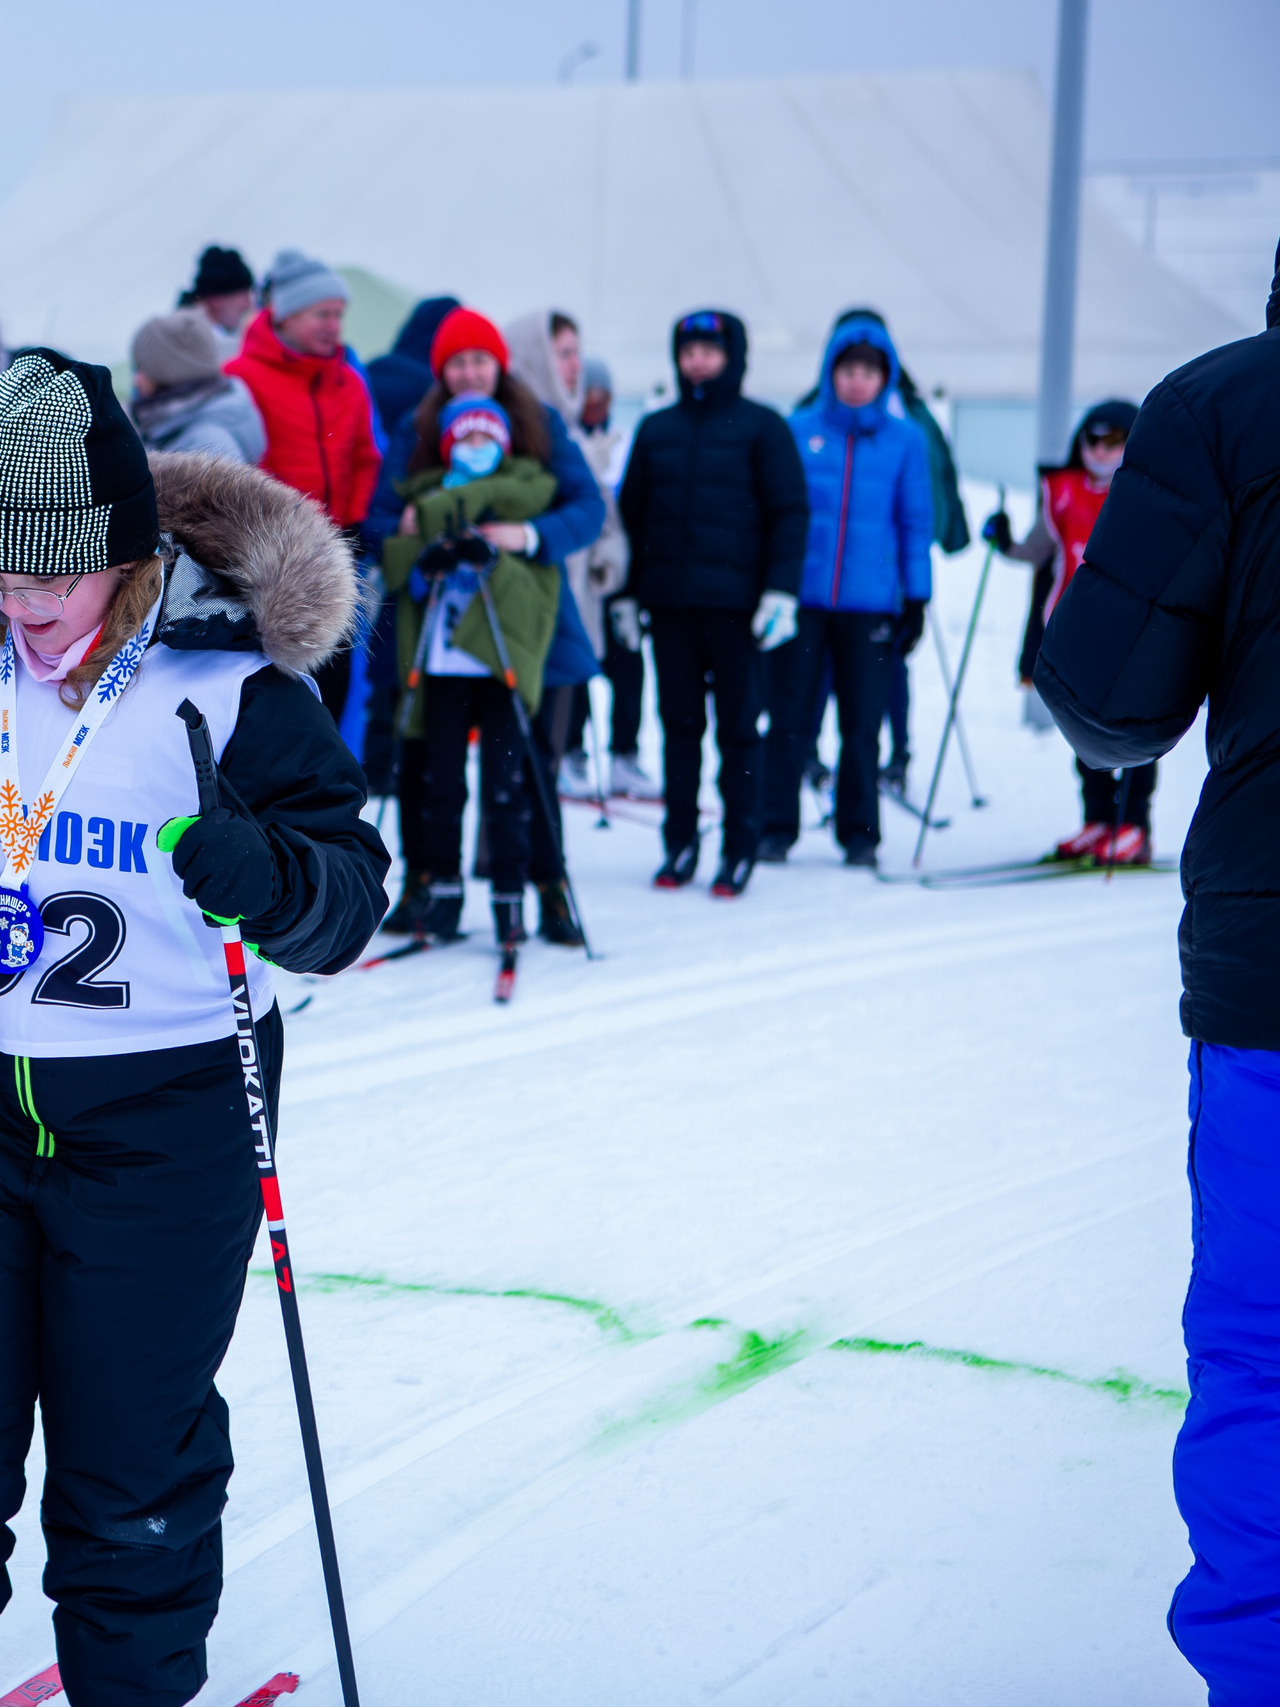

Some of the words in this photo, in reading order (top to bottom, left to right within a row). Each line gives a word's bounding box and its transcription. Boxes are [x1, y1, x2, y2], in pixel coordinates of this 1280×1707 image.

[1, 732, 10, 754] МОЭК
[72, 724, 90, 747] МОЭК
[231, 983, 273, 1169] VUOKATTI
[271, 1238, 292, 1294] A7
[17, 1680, 59, 1702] 157
